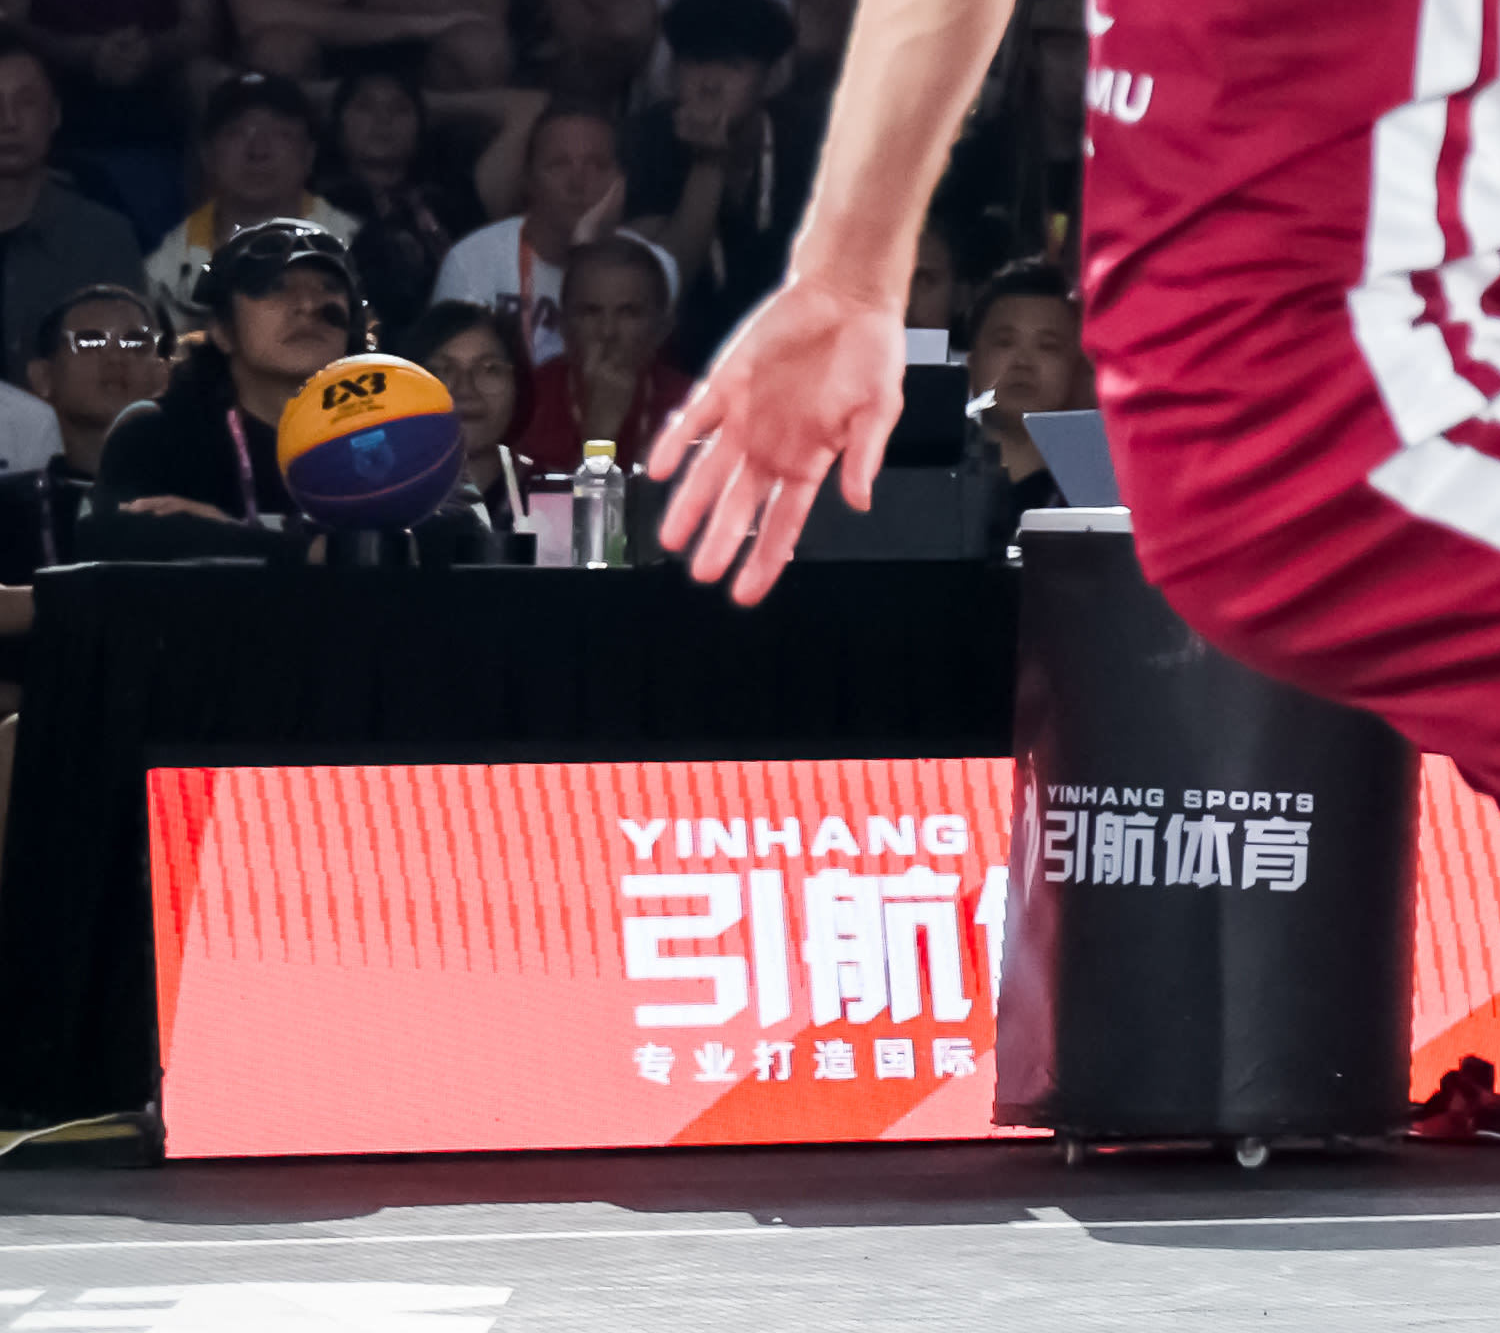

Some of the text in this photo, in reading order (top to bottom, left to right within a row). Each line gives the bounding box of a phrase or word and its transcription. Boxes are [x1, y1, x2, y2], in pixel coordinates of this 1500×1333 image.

[1047, 784, 1314, 813] YINHANG SPORTS
[618, 814, 968, 860] YINHANG
[1044, 810, 1313, 892] 引航体育
[621, 865, 1010, 1029] 引航
